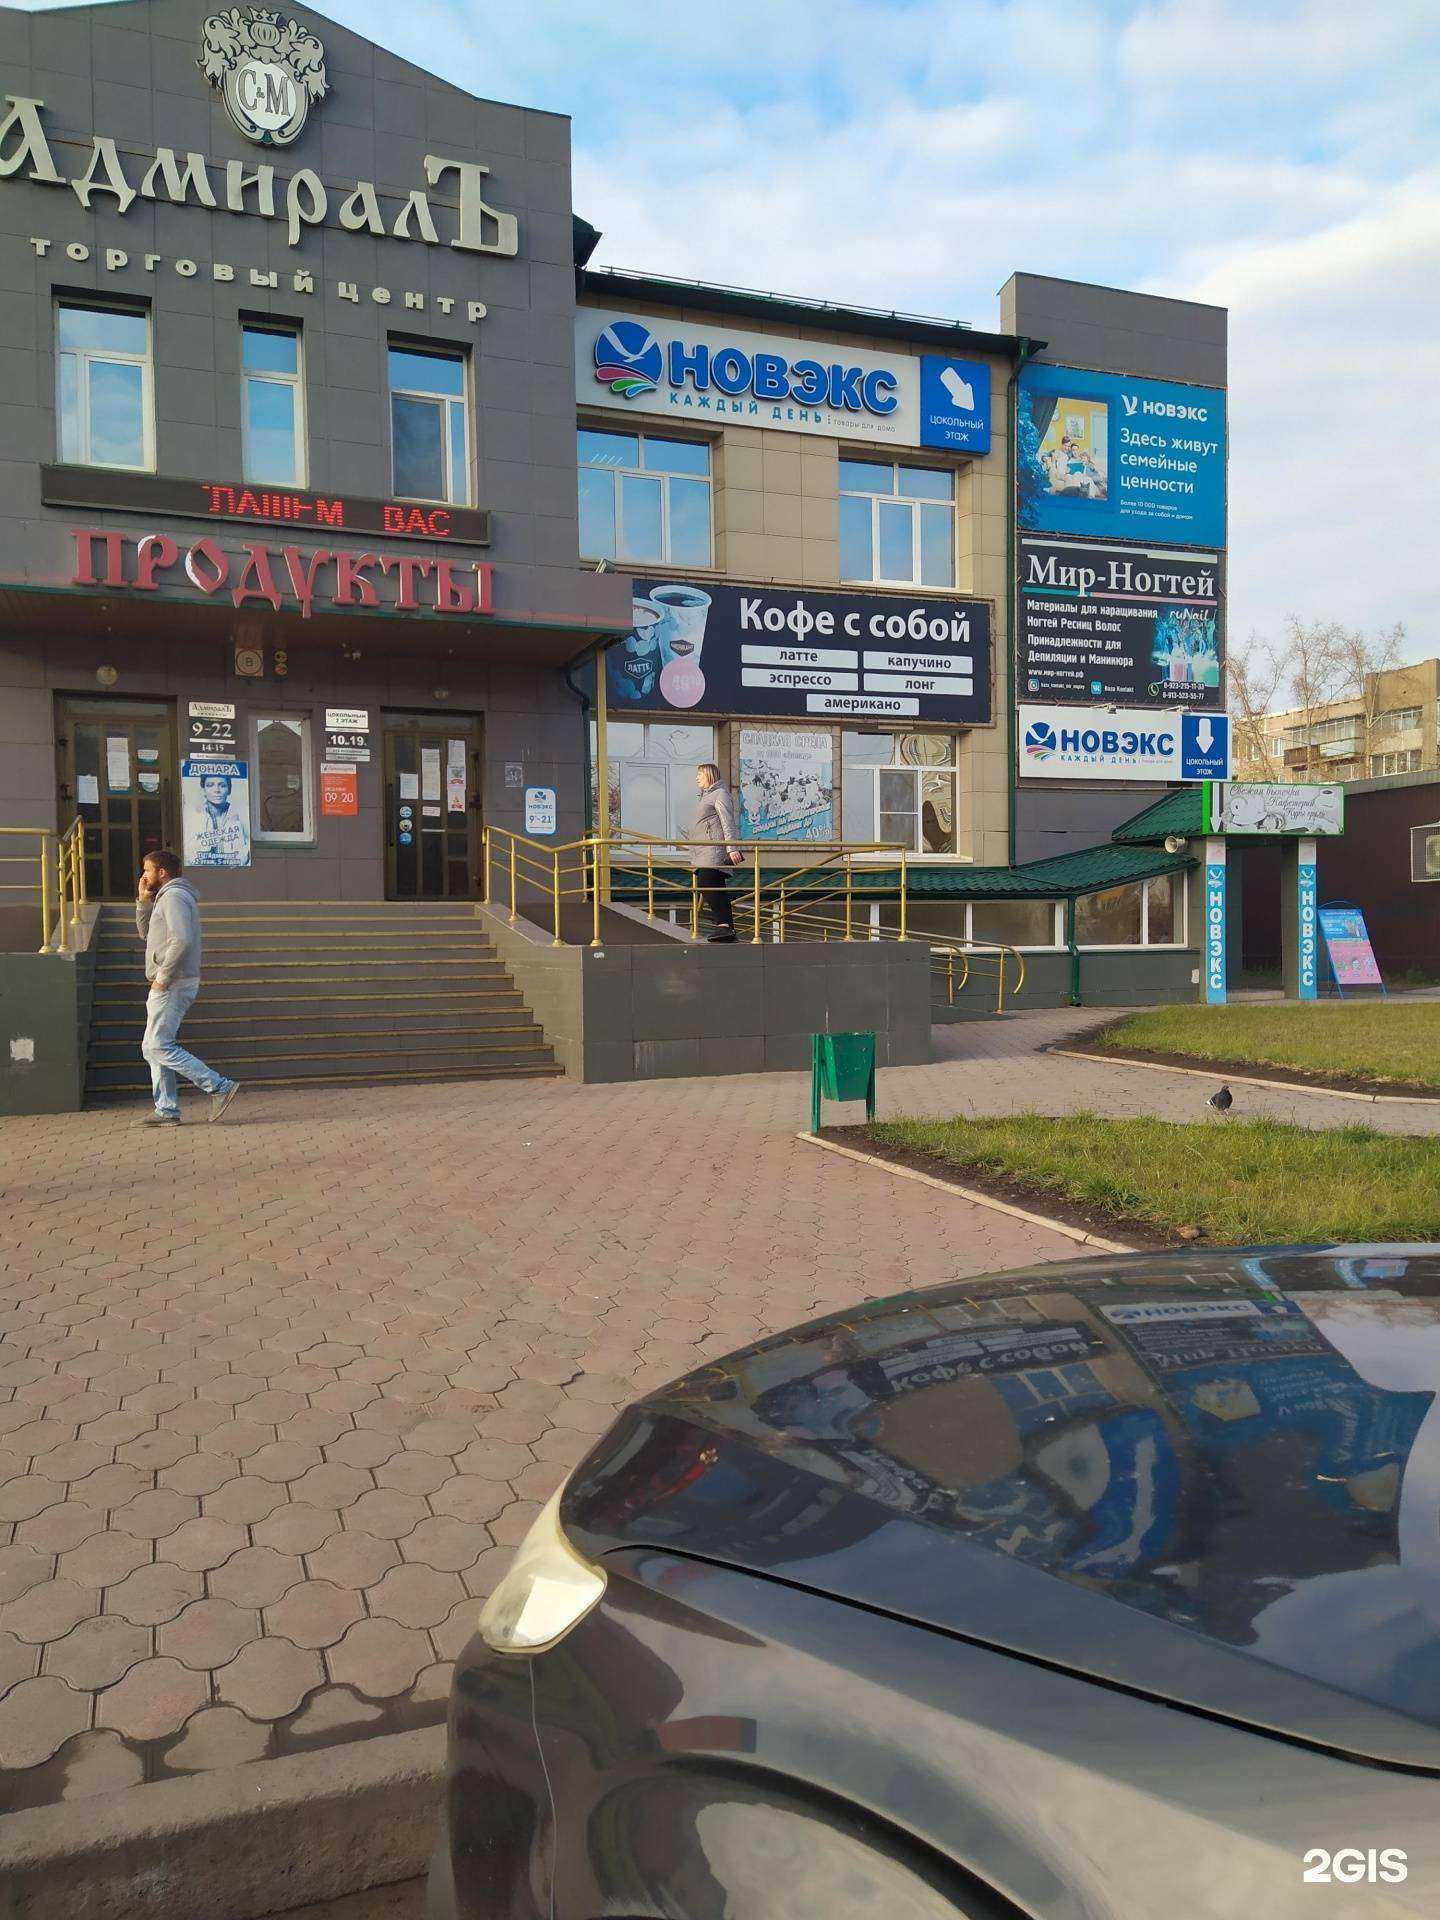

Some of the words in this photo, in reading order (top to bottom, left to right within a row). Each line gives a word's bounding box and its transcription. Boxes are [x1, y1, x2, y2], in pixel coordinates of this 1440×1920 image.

[30, 237, 314, 295] торговый
[338, 281, 488, 323] центр
[667, 340, 900, 417] НОВЭКС
[669, 394, 759, 416] КАЖДЫЙ
[771, 406, 823, 425] ДЕНЬ
[1120, 427, 1167, 449] Здесь
[1171, 436, 1219, 457] живут
[1120, 452, 1199, 474] семейные
[1120, 474, 1195, 494] ценности
[71, 528, 497, 619] ПРОДУКТЫ
[1026, 554, 1215, 598] Мир-Ногтей
[739, 597, 835, 642] Кофе
[843, 611, 861, 637] с
[868, 607, 971, 643] собой
[1026, 599, 1078, 614] Материалы
[1080, 603, 1097, 615] для
[1100, 605, 1158, 619] наращивания
[1027, 616, 1058, 629] Ногтей
[1061, 618, 1092, 632] Ресниц
[1095, 620, 1121, 632] Волос
[1027, 634, 1102, 650] Принадлежности
[1105, 639, 1122, 651] для
[778, 648, 819, 663] латте
[886, 657, 953, 671] капучино
[1027, 650, 1077, 664] Депиляции
[1089, 653, 1134, 668] Маникюра
[768, 673, 833, 688] эспрессо
[904, 678, 937, 691] лонг
[824, 696, 902, 712] американо
[1061, 728, 1175, 756] НОВЭКС
[1060, 754, 1105, 764] КАЖДЫЙ
[1111, 756, 1137, 765] ДЕНЬ
